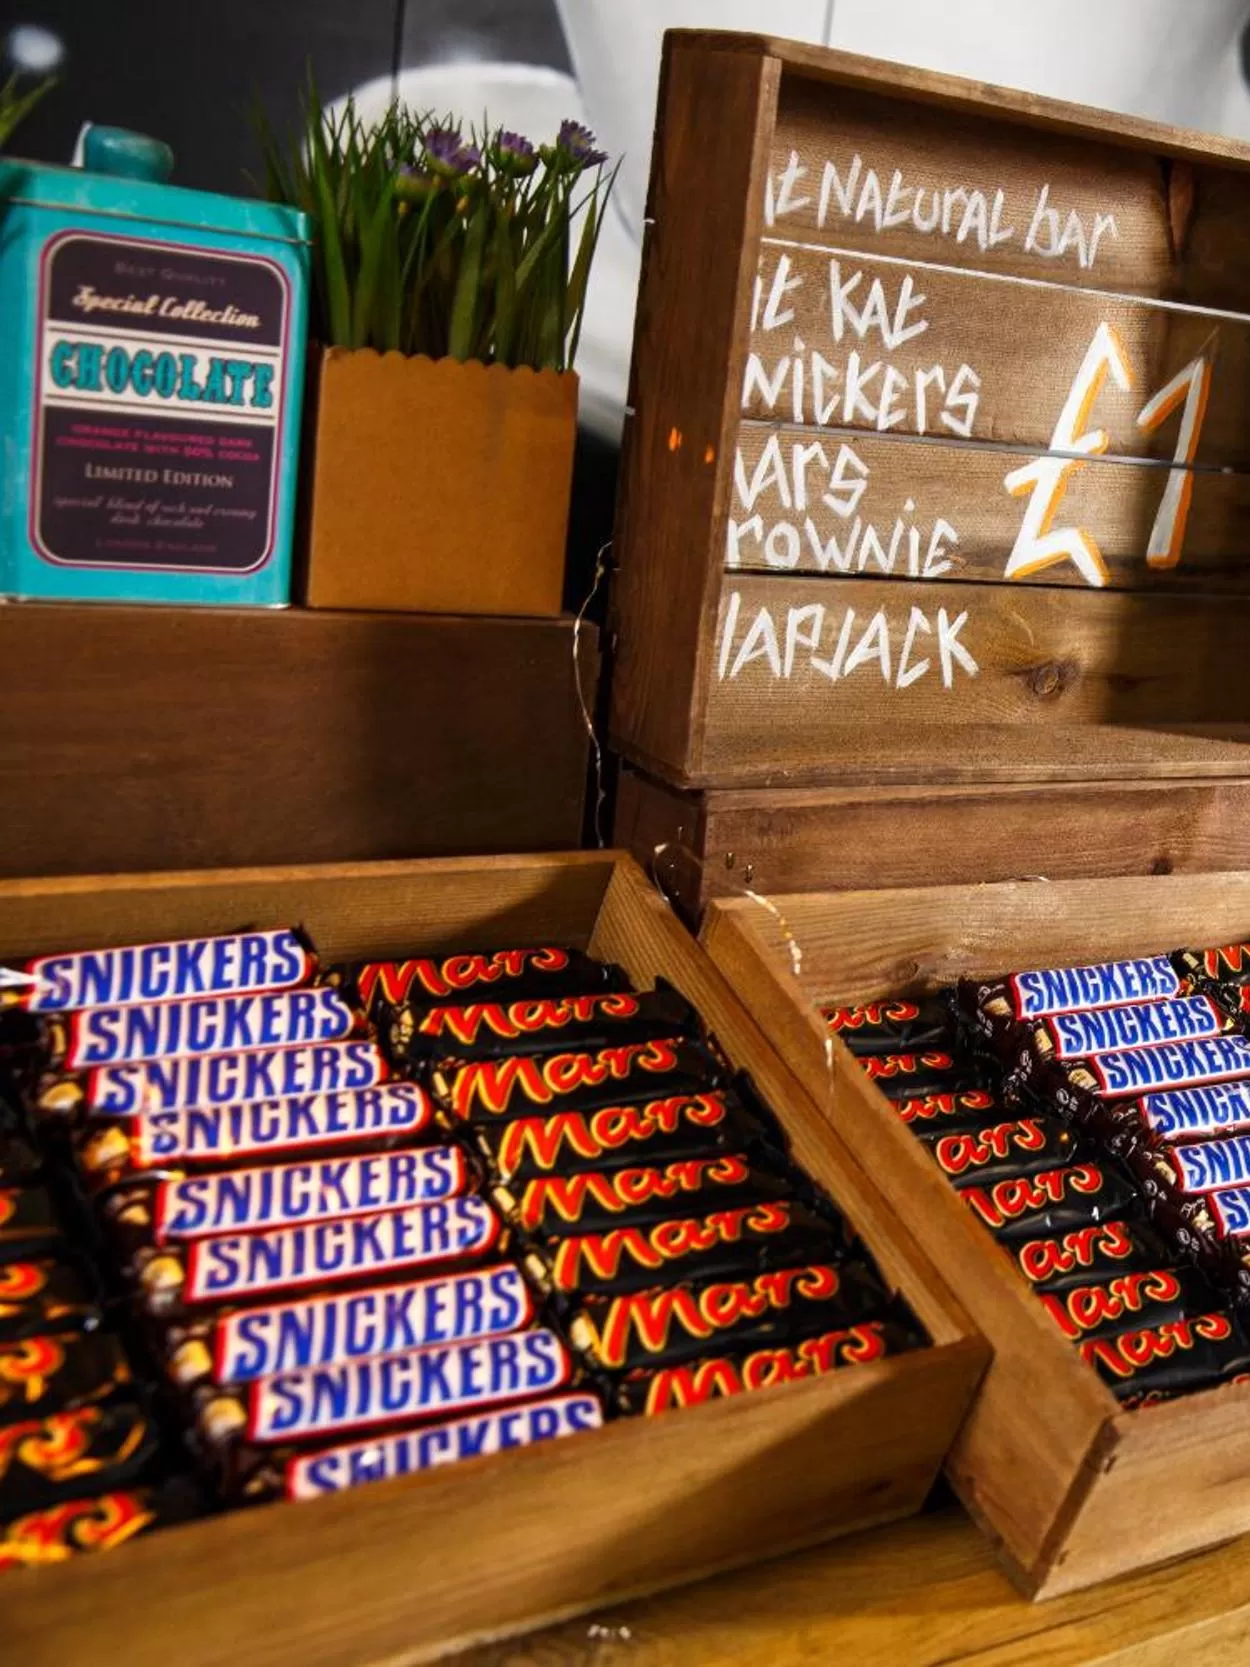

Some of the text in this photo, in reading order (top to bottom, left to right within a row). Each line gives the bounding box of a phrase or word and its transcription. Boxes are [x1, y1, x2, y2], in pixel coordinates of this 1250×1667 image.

[72, 284, 262, 328] Special Collection
[50, 339, 273, 408] CHOCOLATE
[742, 336, 980, 435] NiCKErS
[85, 462, 233, 488] LIMITED EDITION
[734, 433, 869, 517] Ars
[1003, 321, 1213, 587] £1
[726, 499, 960, 576] rOWNiE
[719, 591, 979, 688] lAPJACK
[33, 932, 301, 1009] SNICKERS
[359, 947, 568, 1001] Mars
[1019, 956, 1177, 1015] SNICKERS
[85, 988, 349, 1062] SNICKERS
[418, 993, 638, 1043] Mars
[1054, 997, 1217, 1055] SNICKERS
[97, 1044, 377, 1114] SNICKERS
[452, 1038, 679, 1118] Mars
[150, 1084, 420, 1153] SNICKERS
[500, 1090, 726, 1172] Mars
[937, 1117, 1046, 1173] ars
[168, 1146, 452, 1231] SNICKERS
[522, 1154, 748, 1228] Mars
[960, 1163, 1103, 1228] ars
[205, 1195, 487, 1289] SNICKERS
[553, 1200, 789, 1290] Mars
[1019, 1221, 1132, 1281] ars
[234, 1268, 521, 1380] SNICKERS
[600, 1264, 838, 1368] Mars
[1039, 1269, 1180, 1340] ars
[270, 1331, 556, 1429] SNICKERS
[645, 1322, 885, 1416] Mars
[1080, 1312, 1231, 1377] ars
